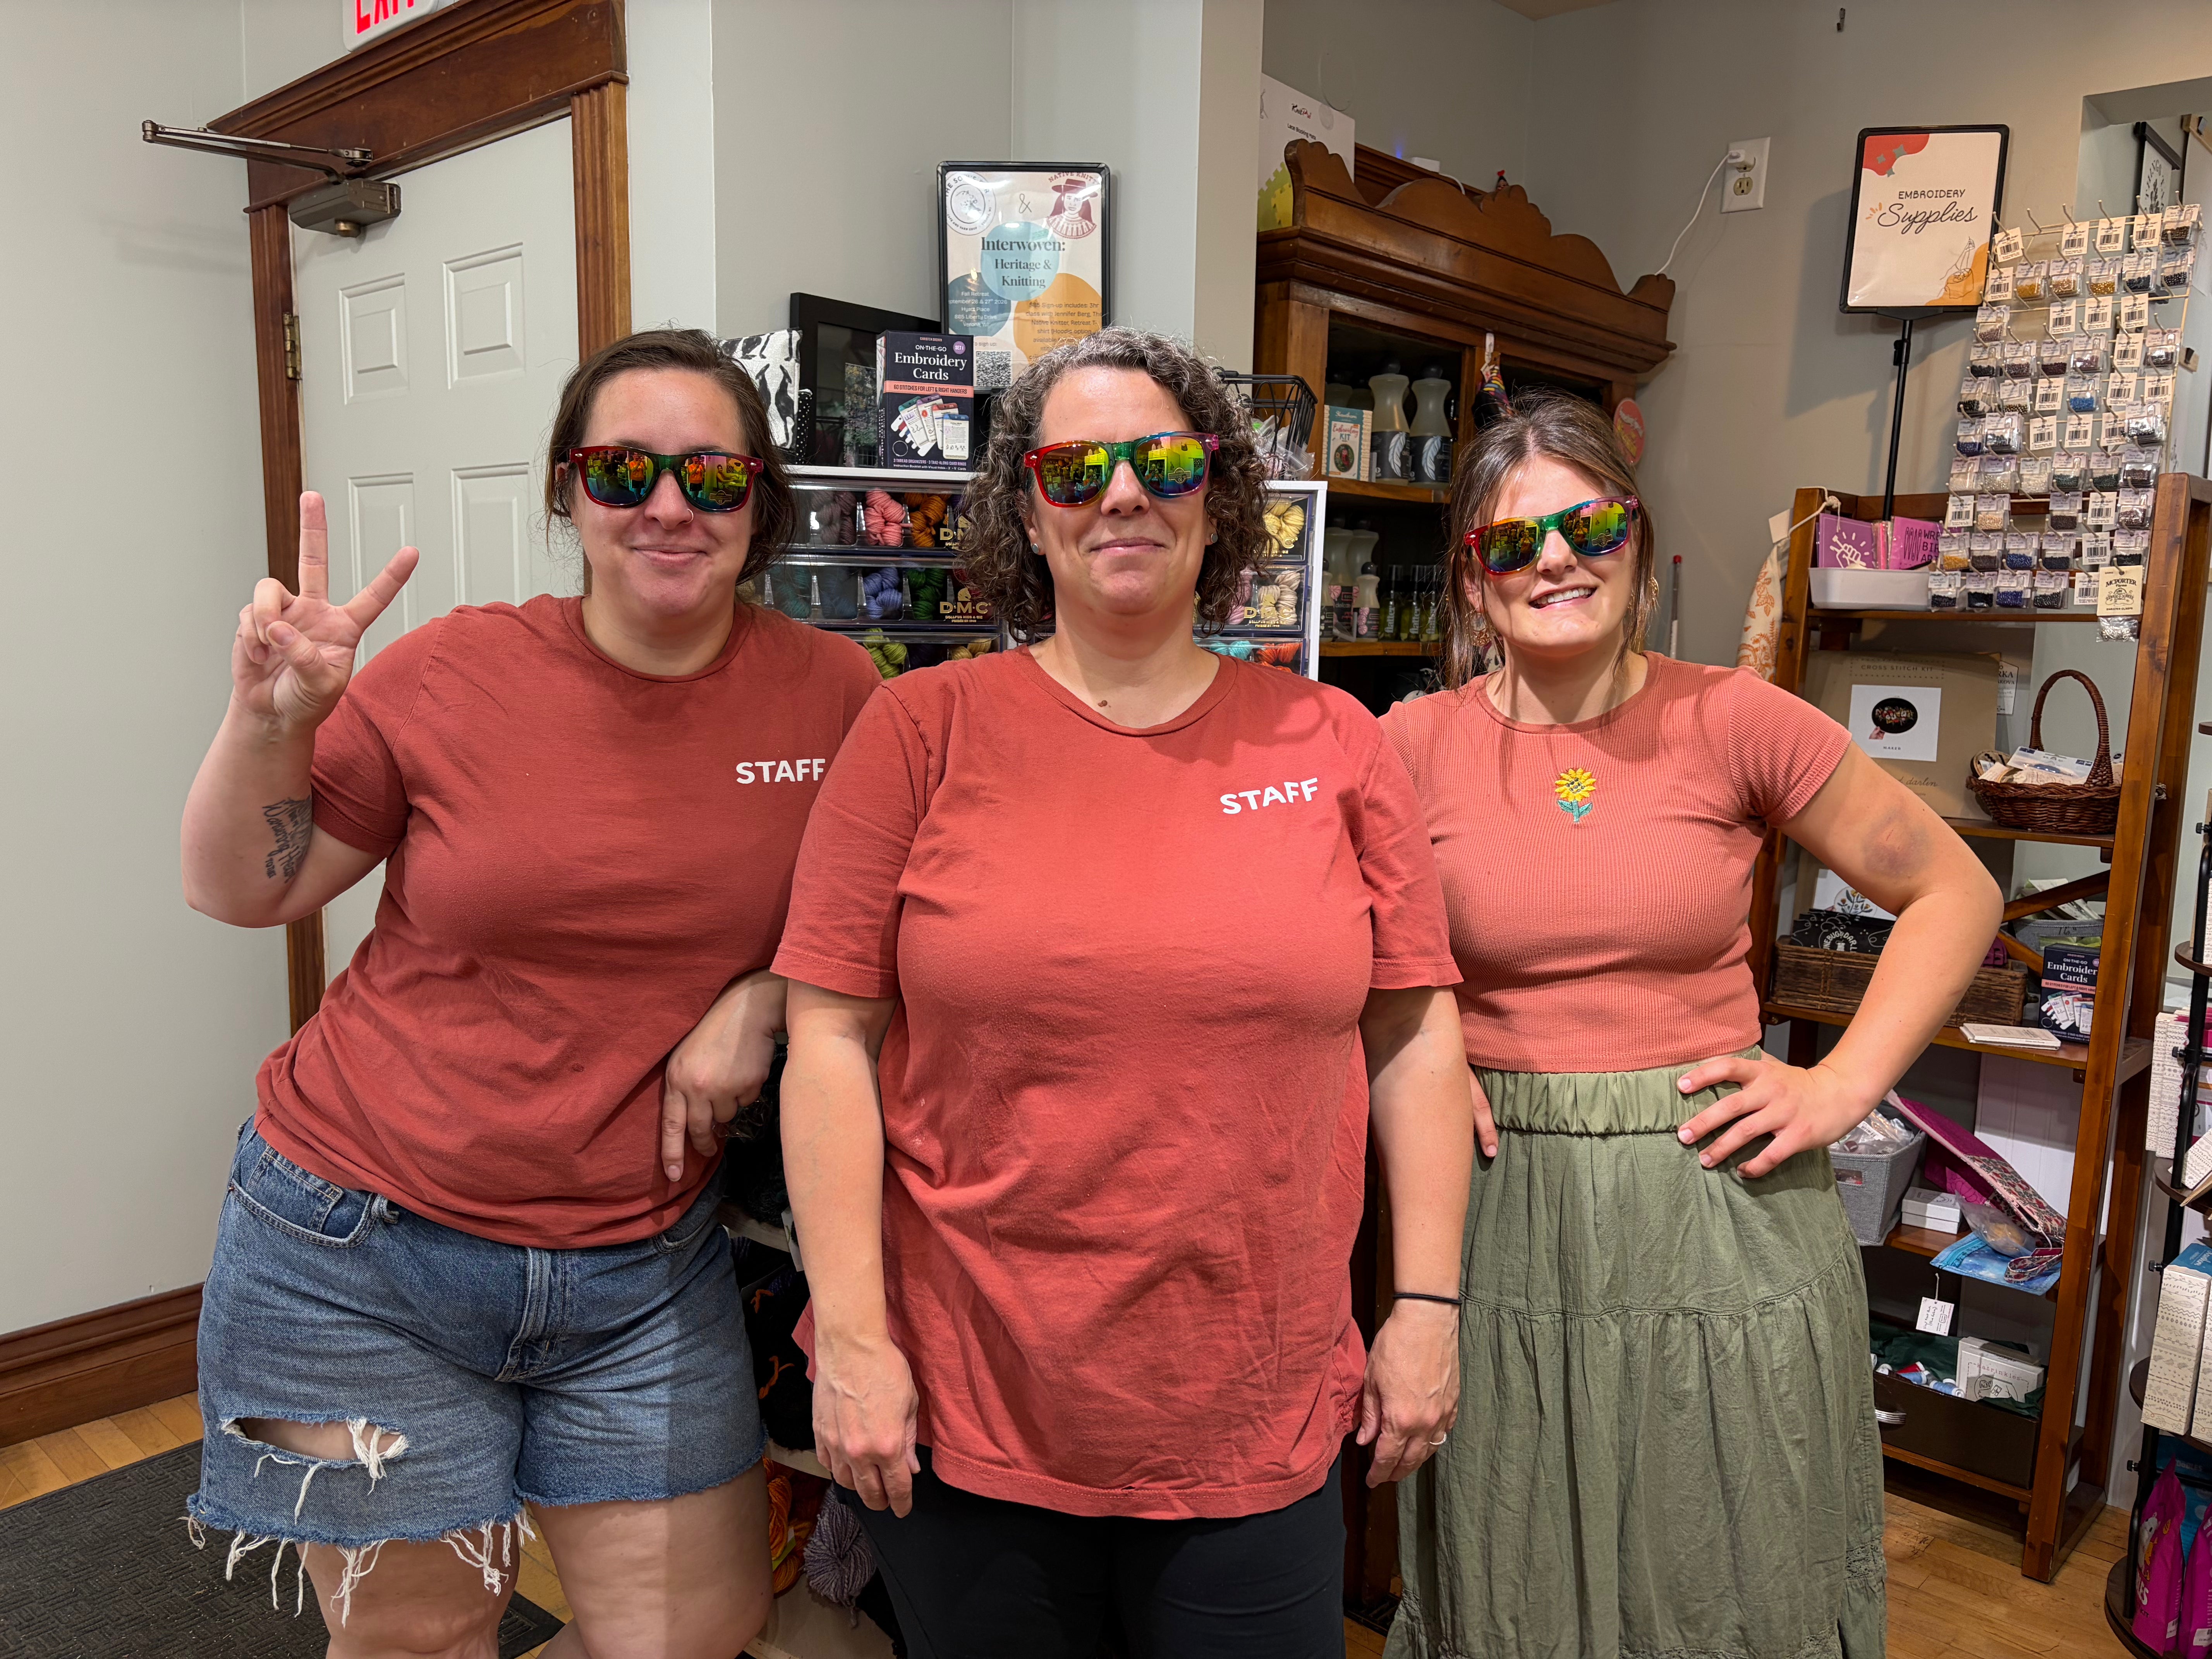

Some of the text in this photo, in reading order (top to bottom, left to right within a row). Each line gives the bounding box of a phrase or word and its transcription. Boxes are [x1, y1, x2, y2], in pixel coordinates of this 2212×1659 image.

[1048, 172, 1074, 182] NATIVE
[1898, 189, 1965, 199] EMBROIDERY
[1019, 193, 1032, 214] &
[1877, 201, 1977, 234] Supplies
[981, 237, 1065, 251] Interwoven:
[995, 259, 1052, 272] Heritage &
[1002, 275, 1046, 289] Knitting
[895, 352, 967, 371] Embroidery
[913, 368, 949, 380] Cards
[1924, 529, 1939, 540] WRE
[736, 759, 826, 784] STAFF
[1220, 777, 1318, 814] STAFF
[2047, 961, 2098, 975] Embroider
[2060, 972, 2088, 983] Cards
